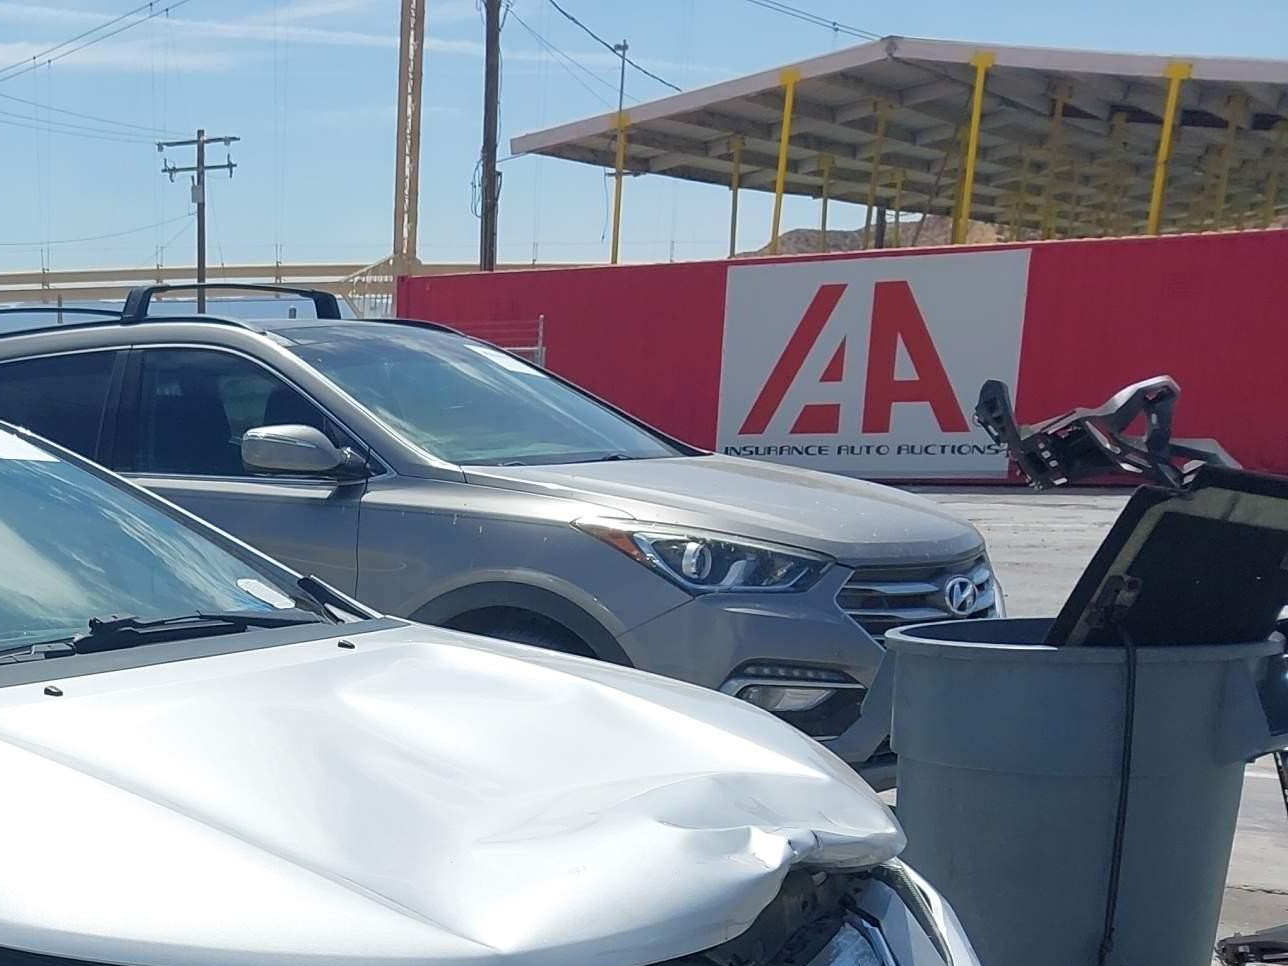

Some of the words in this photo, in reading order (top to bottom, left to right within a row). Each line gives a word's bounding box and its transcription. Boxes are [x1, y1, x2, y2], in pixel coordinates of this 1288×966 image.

[737, 279, 970, 436] IAA
[724, 445, 829, 456] INSURANCE
[837, 445, 890, 456] AUTO
[897, 443, 1000, 456] AUCTIONS
